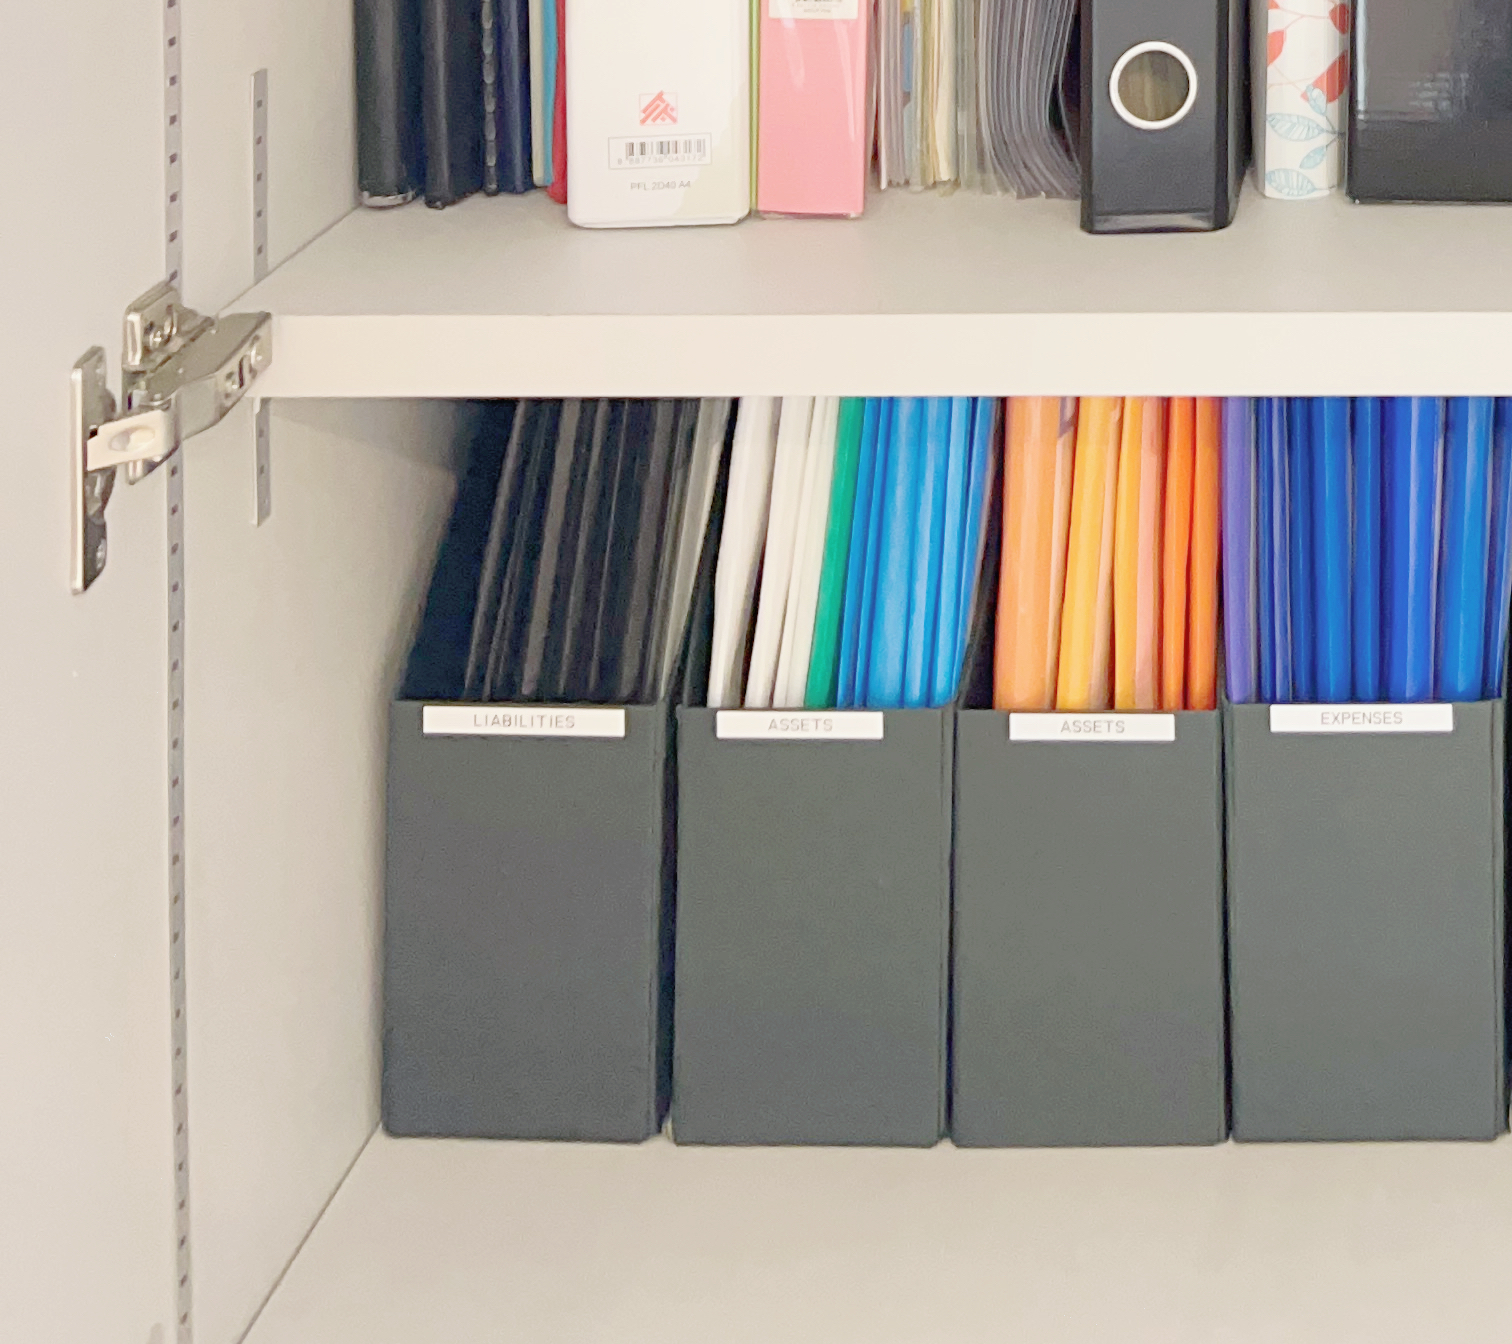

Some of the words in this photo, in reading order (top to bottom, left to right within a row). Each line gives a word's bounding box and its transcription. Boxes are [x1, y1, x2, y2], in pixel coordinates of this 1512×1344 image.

[473, 713, 575, 729] LIABILITIES
[767, 717, 833, 732] ASSETS
[1320, 711, 1403, 726] EXPENSES
[1060, 719, 1126, 734] ASSETS
